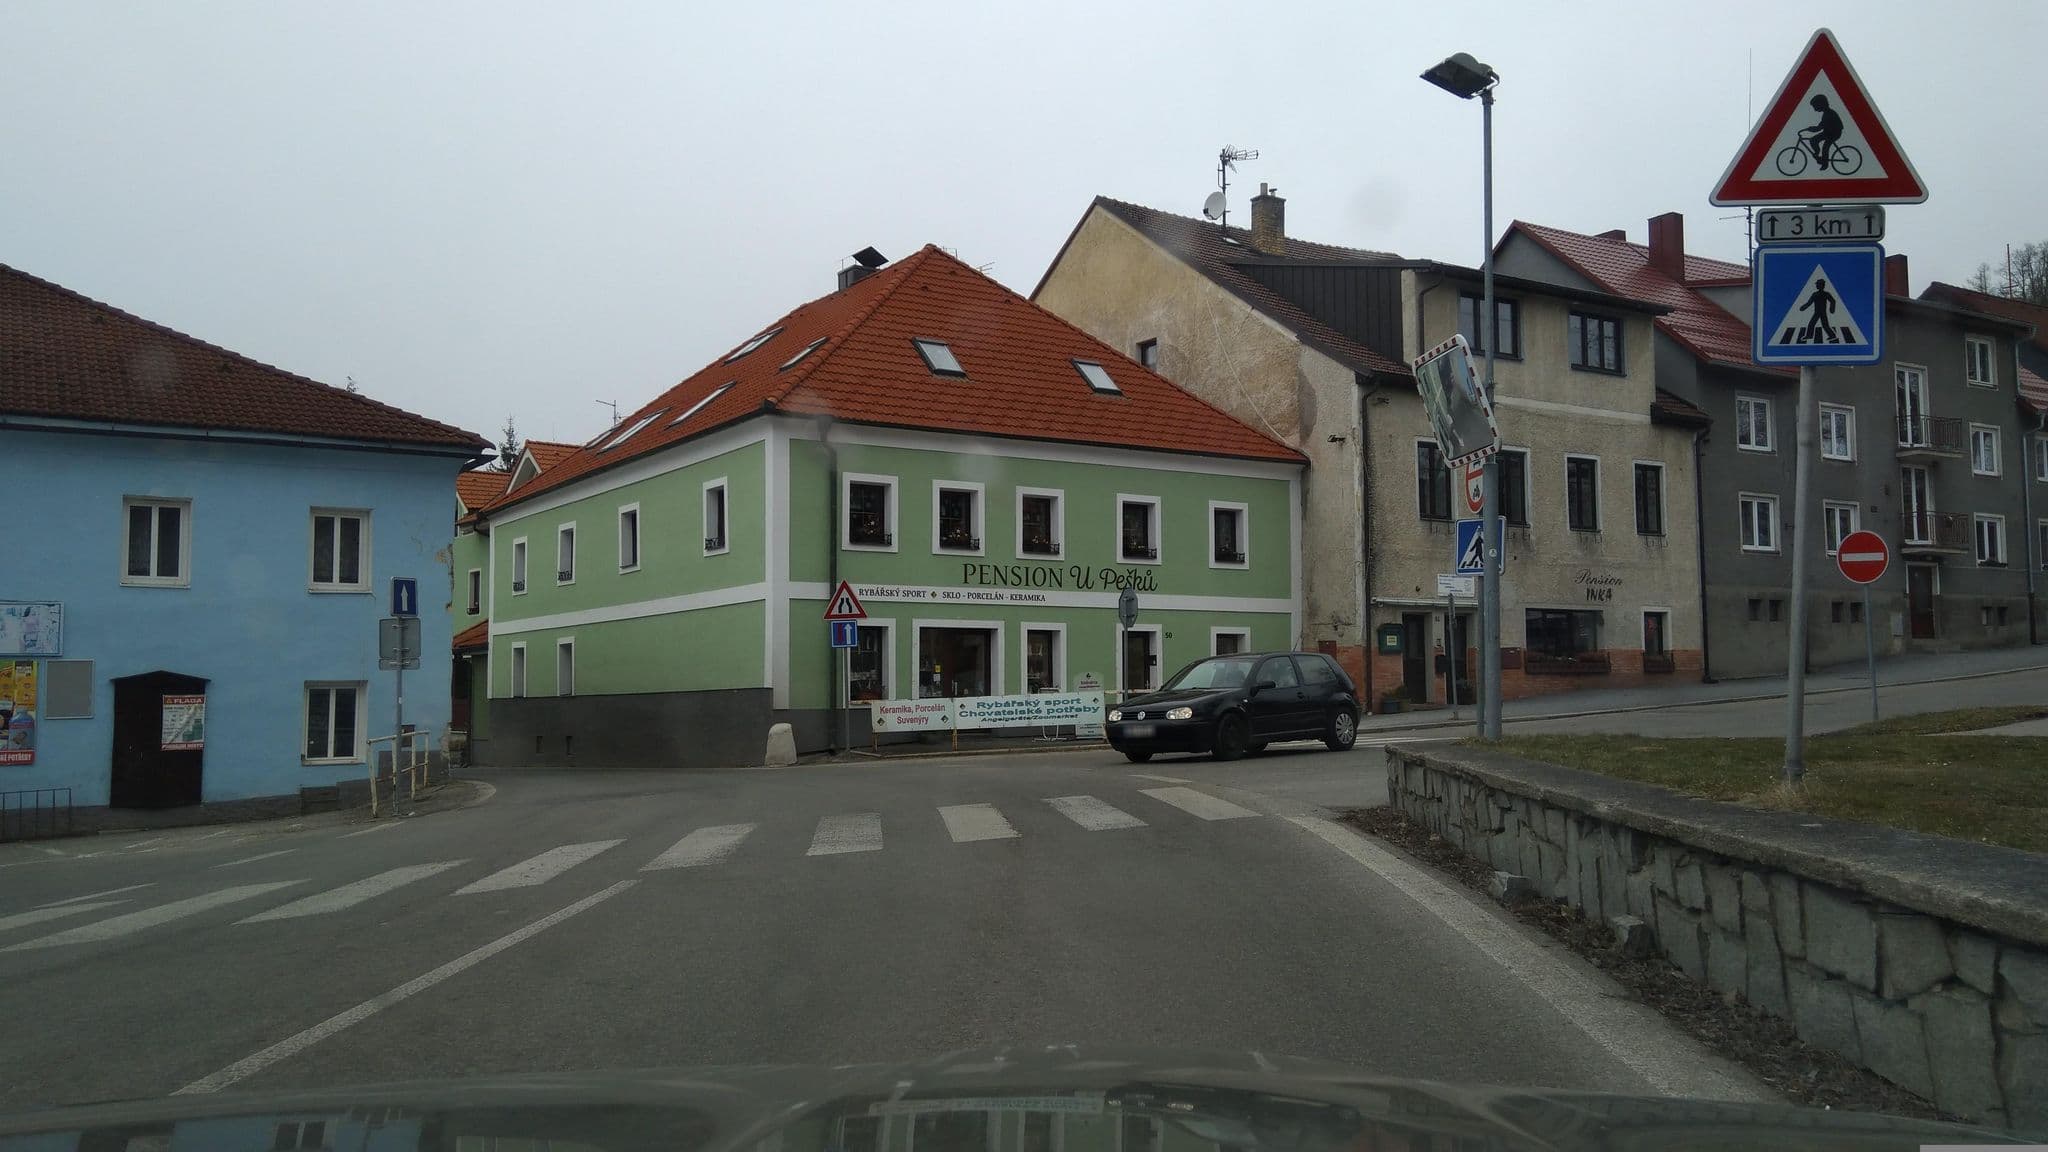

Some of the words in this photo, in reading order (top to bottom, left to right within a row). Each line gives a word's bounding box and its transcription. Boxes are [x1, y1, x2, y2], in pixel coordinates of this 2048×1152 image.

[1790, 215, 1804, 236] 3
[1814, 215, 1851, 236] km
[963, 563, 1064, 588] PENSION
[1069, 565, 1095, 589] U
[1099, 568, 1158, 592] Pešků
[1574, 568, 1622, 586] Pension
[858, 586, 900, 598] RYBÁŘSKÝ
[902, 589, 927, 598] SPORT
[942, 591, 962, 600] SKLO
[967, 590, 1005, 601] PORCELÁN
[1009, 593, 1046, 602] KERAMIKA
[1586, 588, 1612, 601] INKA
[1164, 631, 1173, 639] 50
[915, 703, 946, 713] Porcelán
[976, 698, 1041, 710] Rybářský
[1044, 697, 1082, 707] sport
[958, 706, 1043, 719] Chovatelské
[1046, 704, 1100, 715] potřeby
[896, 715, 929, 725] Suvenýry
